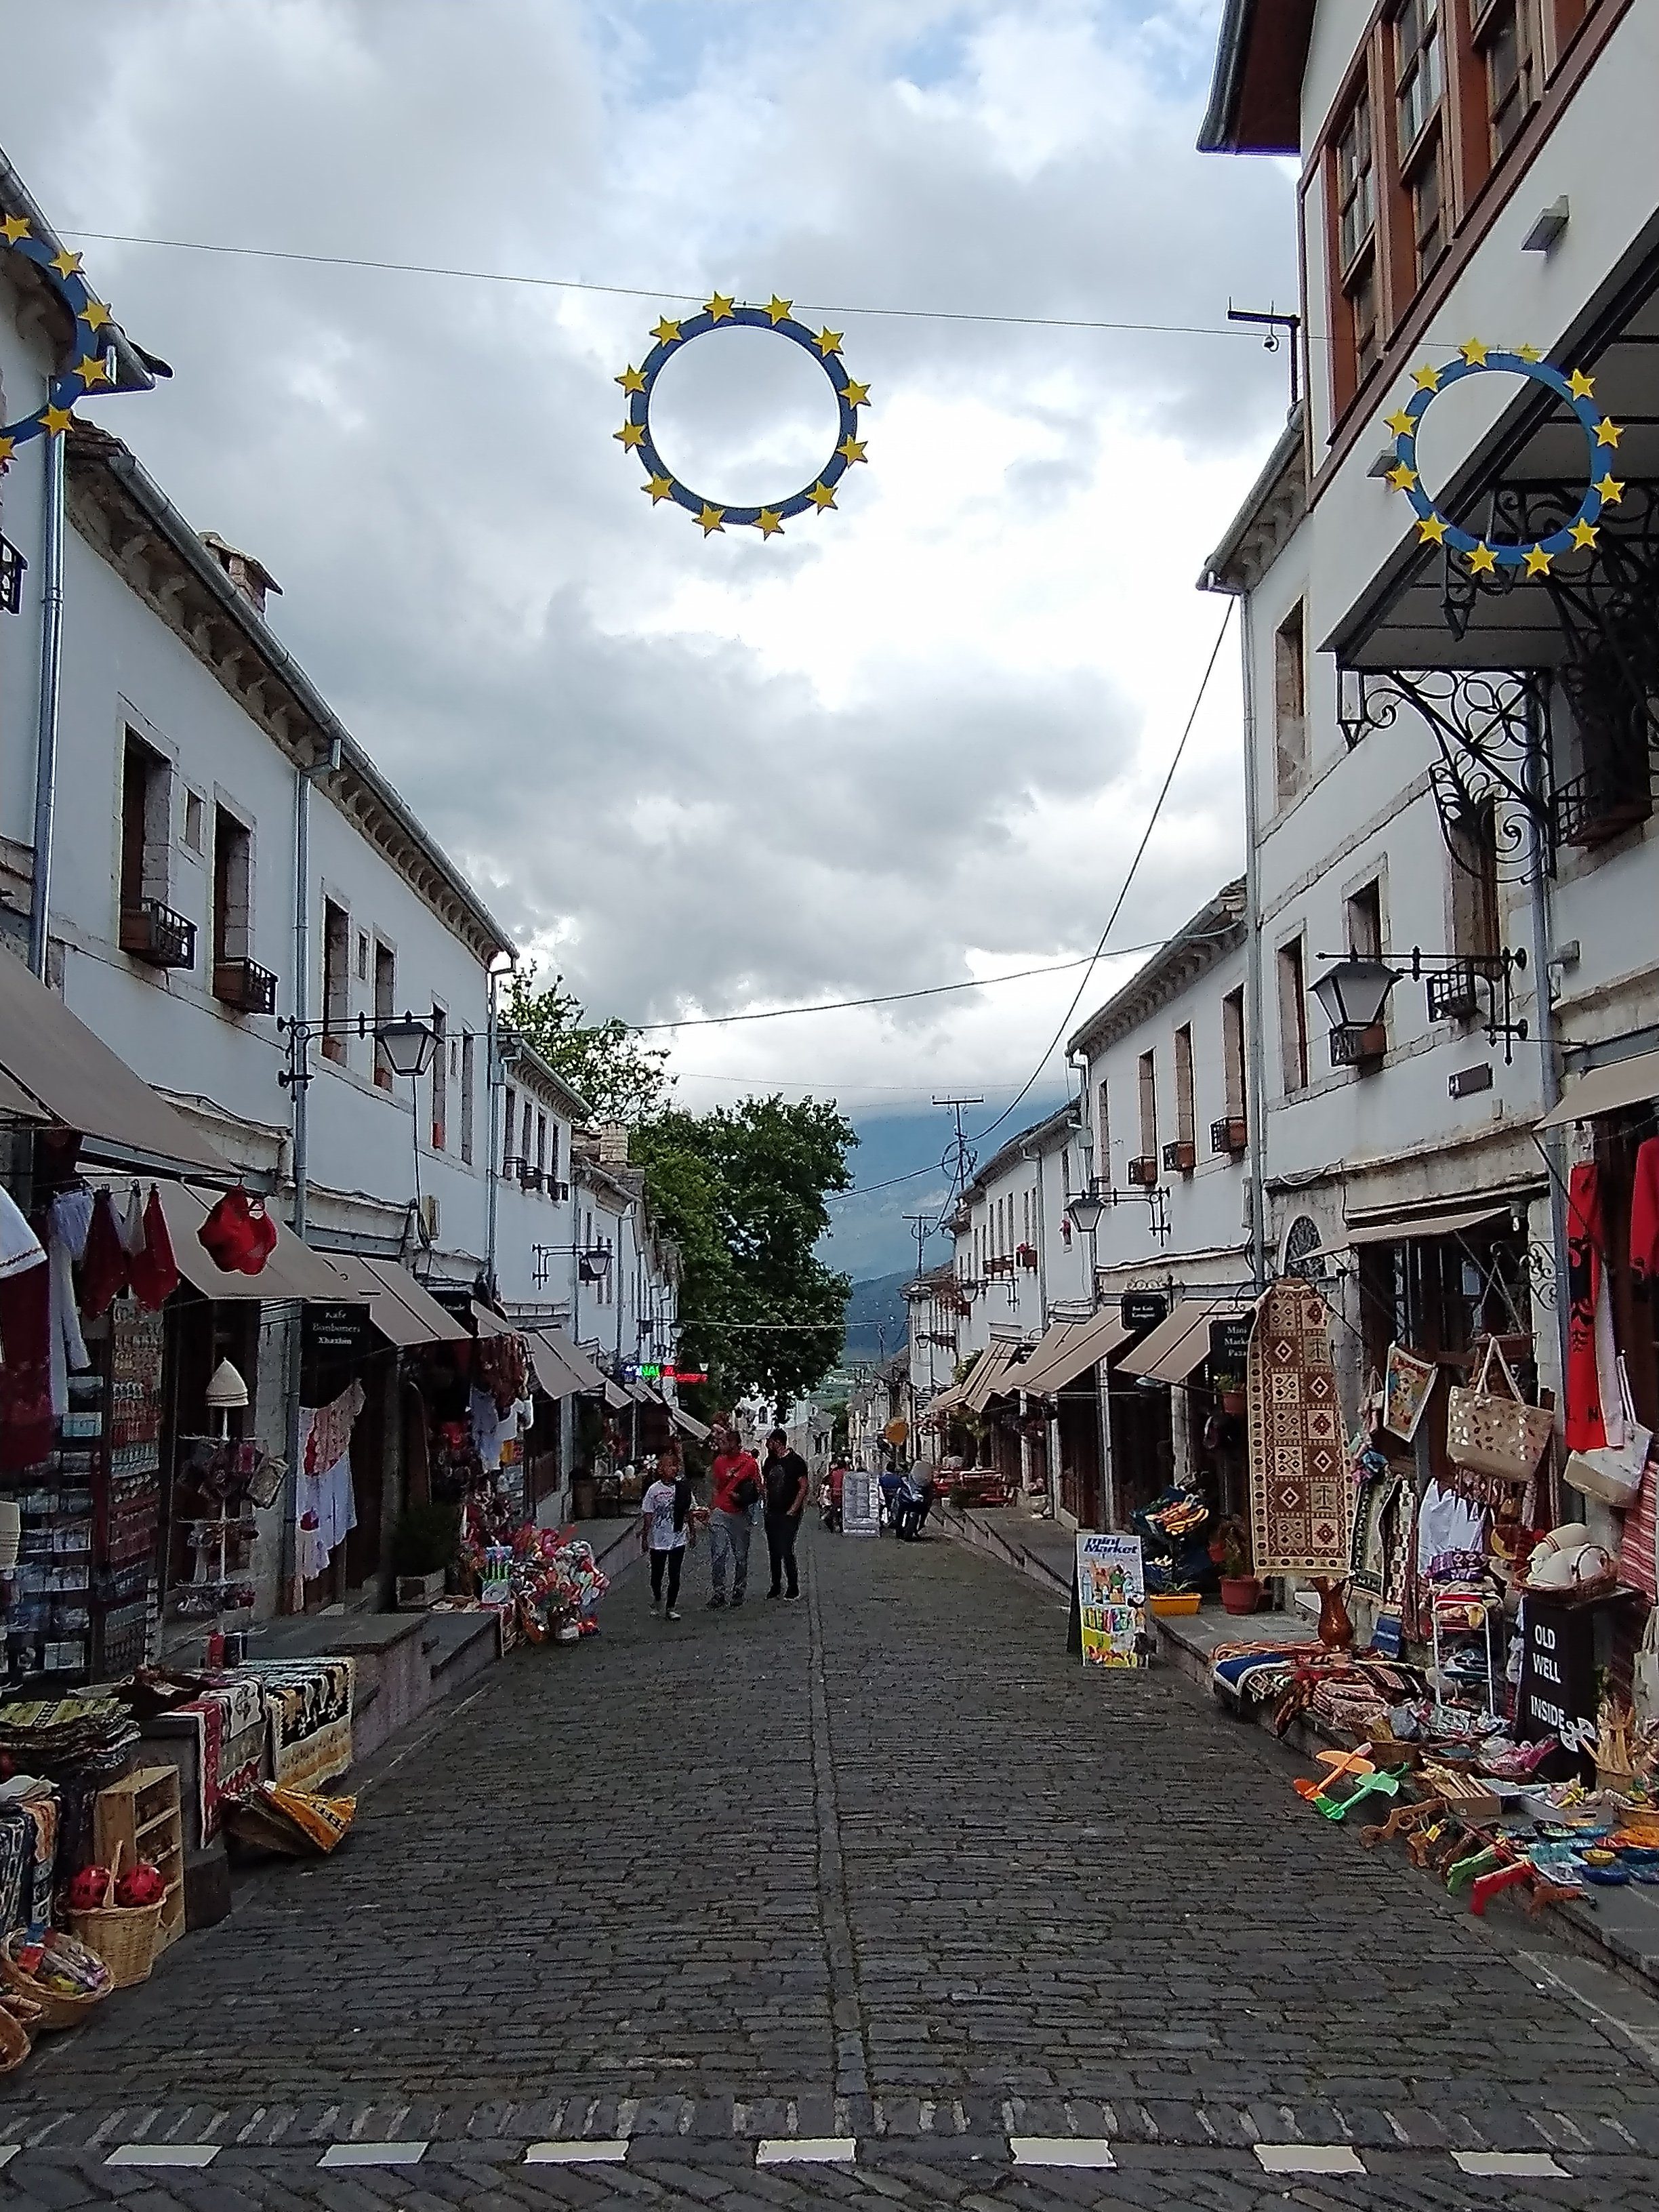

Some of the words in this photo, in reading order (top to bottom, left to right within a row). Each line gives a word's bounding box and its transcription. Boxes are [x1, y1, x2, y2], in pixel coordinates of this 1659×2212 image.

[325, 1309, 346, 1319] Kafe
[1227, 1326, 1247, 1334] Mini
[1084, 1544, 1138, 1554] Market
[1534, 1624, 1555, 1650] OLD
[1532, 1652, 1561, 1684] WELL
[1530, 1695, 1565, 1730] INSIDE
